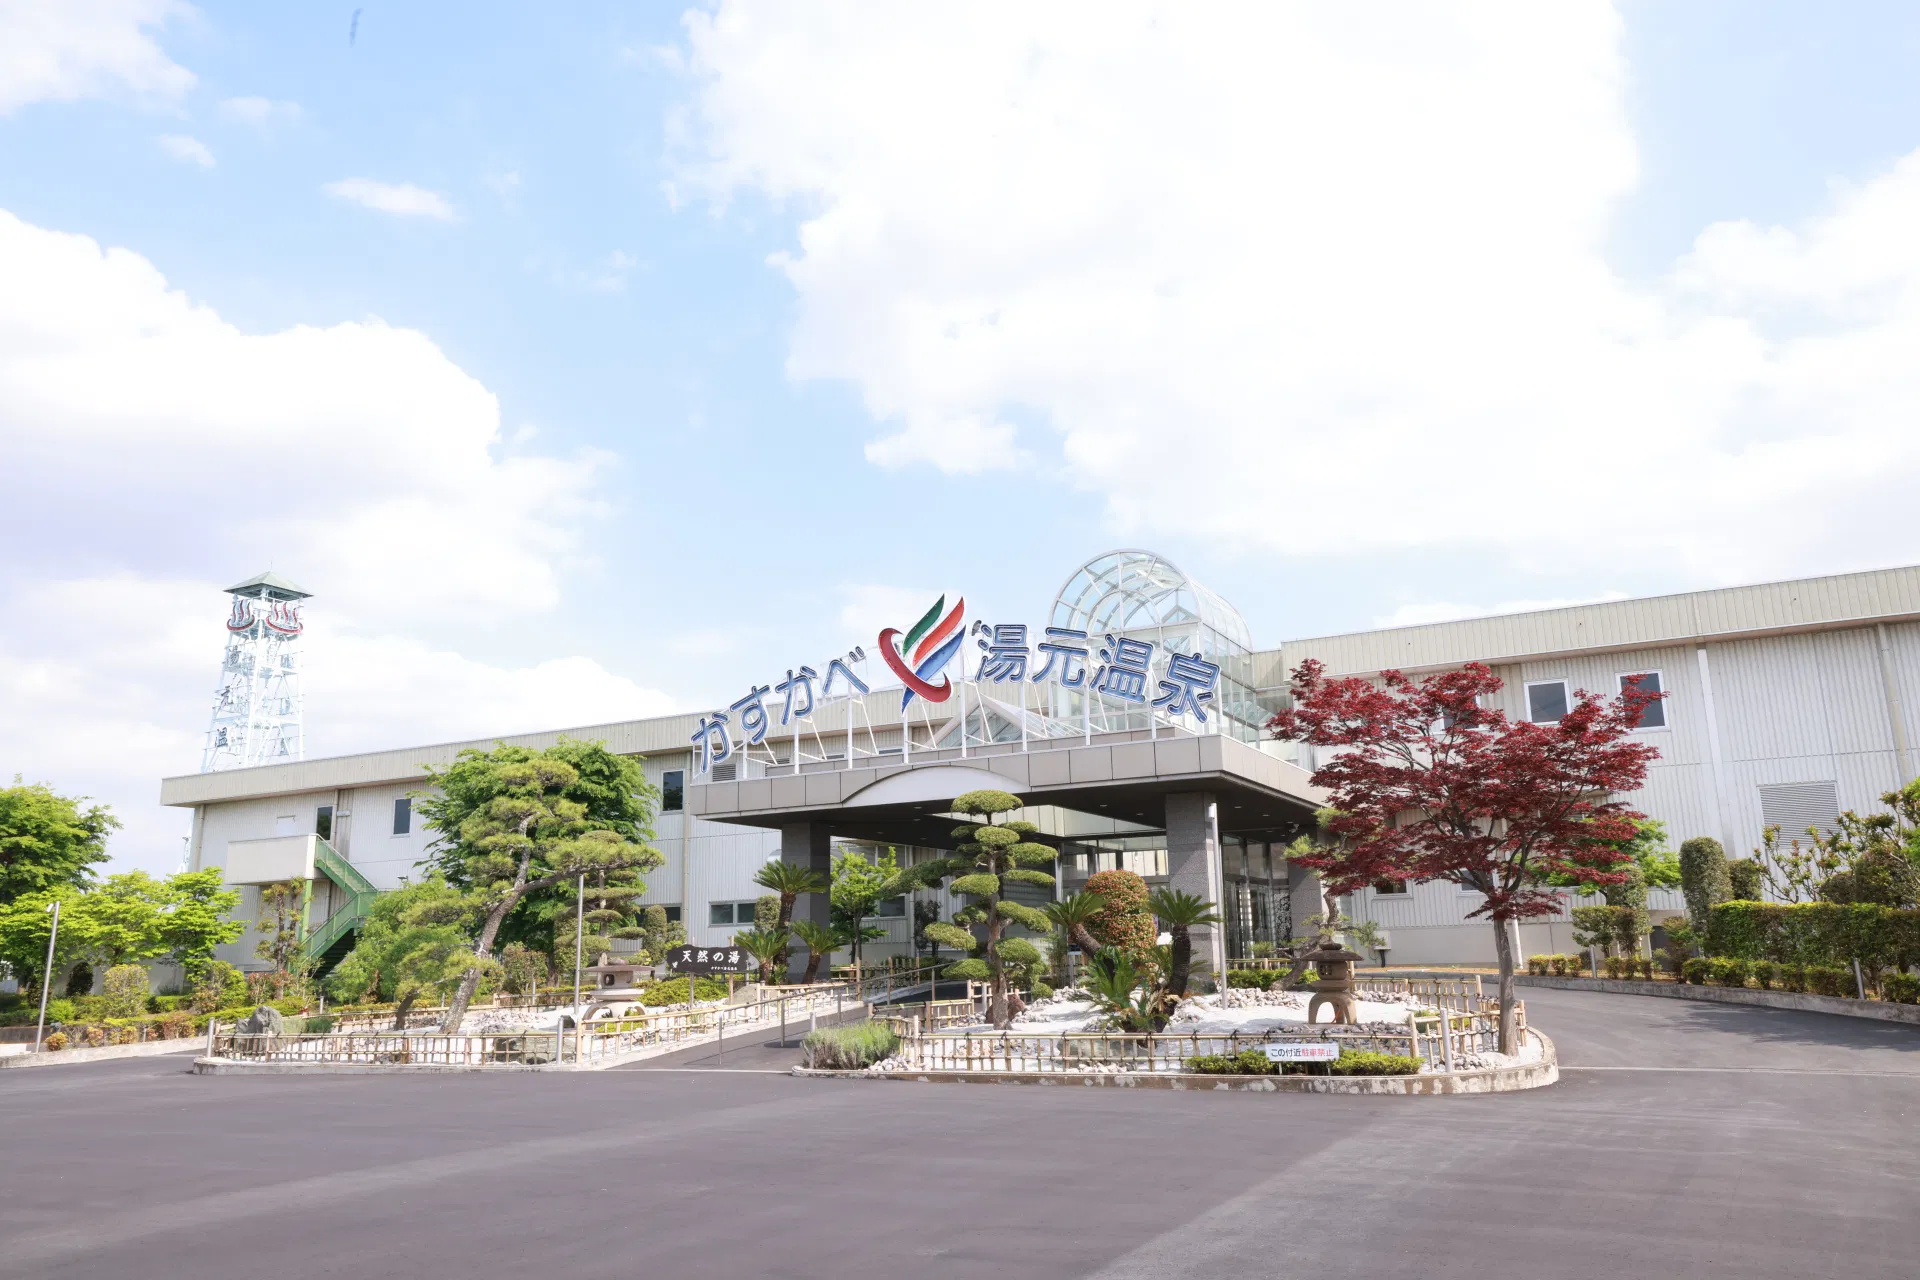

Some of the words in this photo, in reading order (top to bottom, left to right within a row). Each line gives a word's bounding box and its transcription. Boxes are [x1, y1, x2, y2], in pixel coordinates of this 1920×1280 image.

[690, 646, 871, 774] かすかべ
[975, 623, 1221, 724] 湯元温泉
[681, 950, 740, 964] 天然の湯
[1271, 1048, 1334, 1057] この付近駐車禁止
